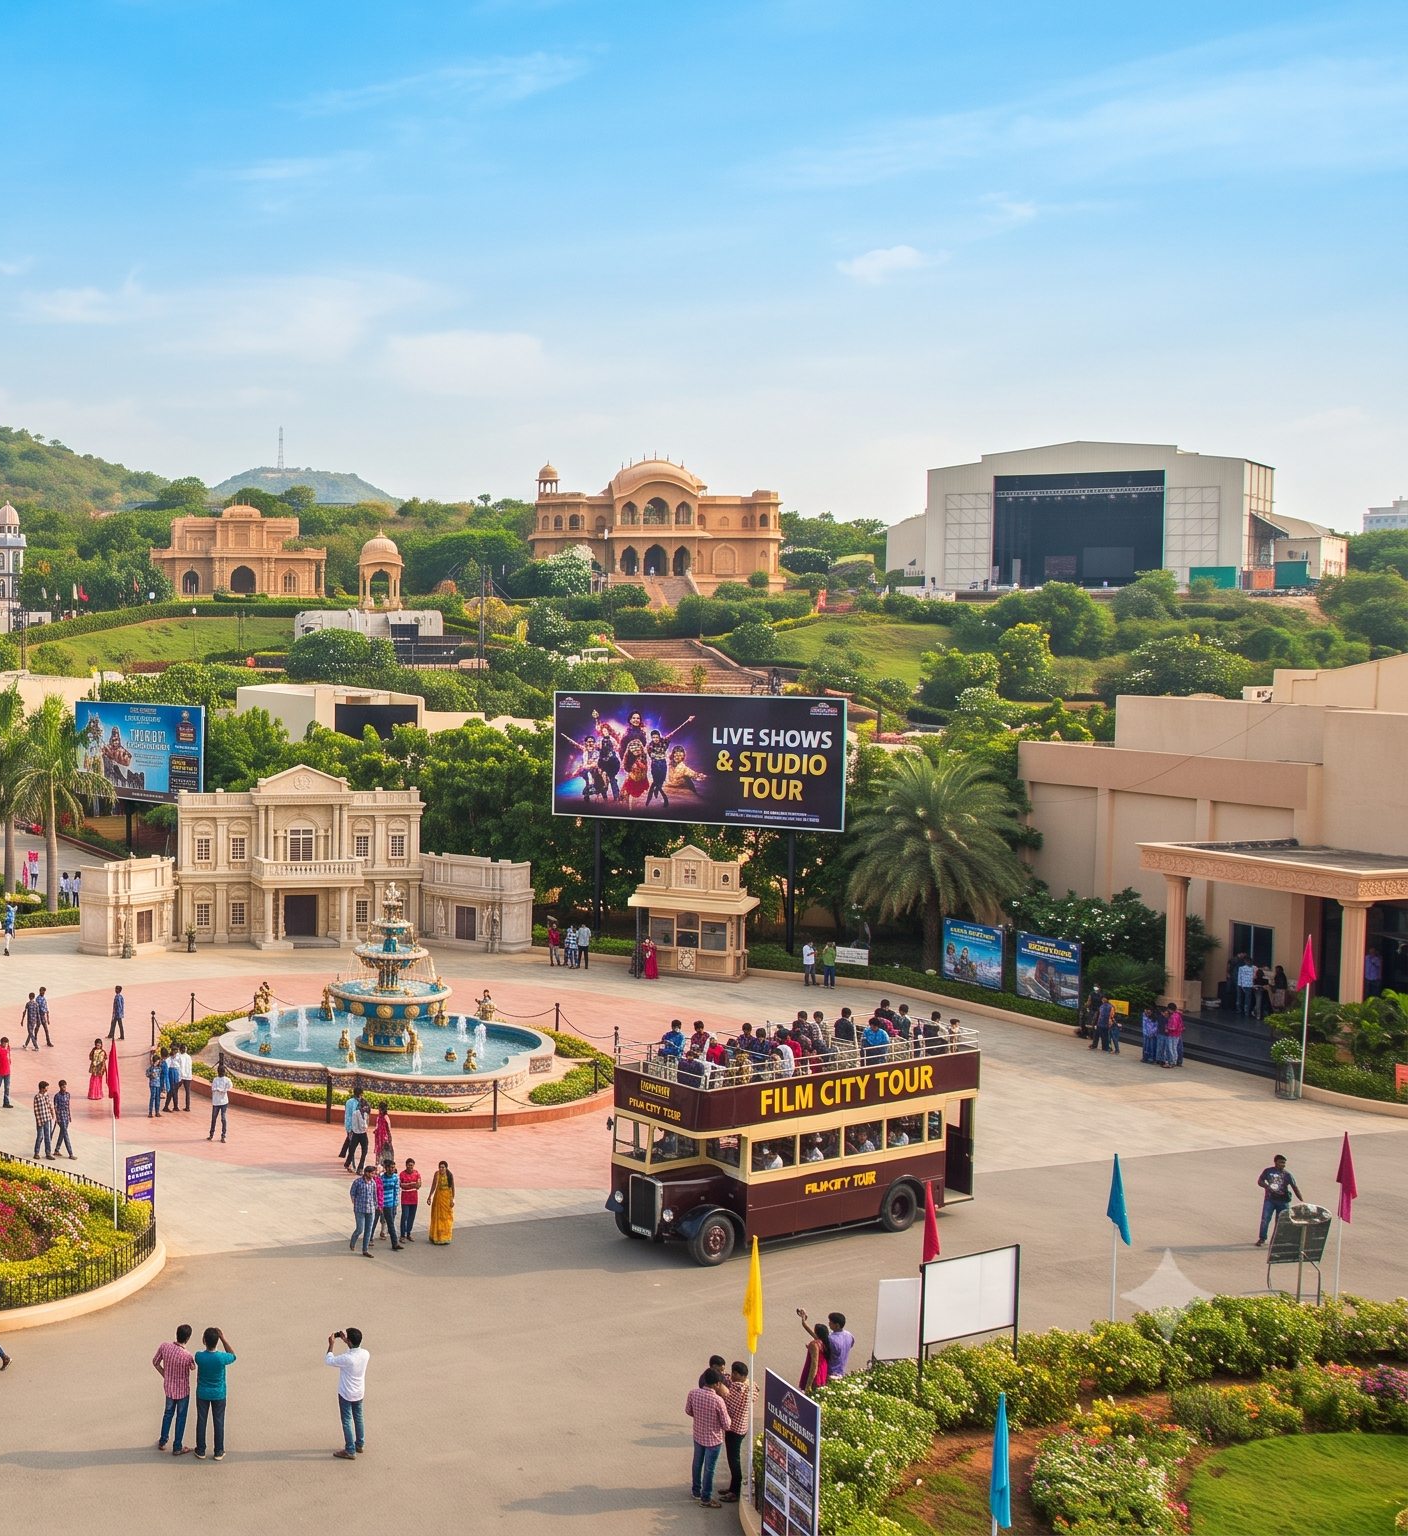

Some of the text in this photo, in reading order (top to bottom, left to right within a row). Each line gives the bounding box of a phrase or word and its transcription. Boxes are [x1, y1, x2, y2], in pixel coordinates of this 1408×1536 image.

[712, 727, 833, 749] LIVE SHOWS
[716, 750, 828, 776] & STUDIO
[739, 776, 803, 801] TOUR
[760, 1065, 934, 1116] FILM CITY TOUR
